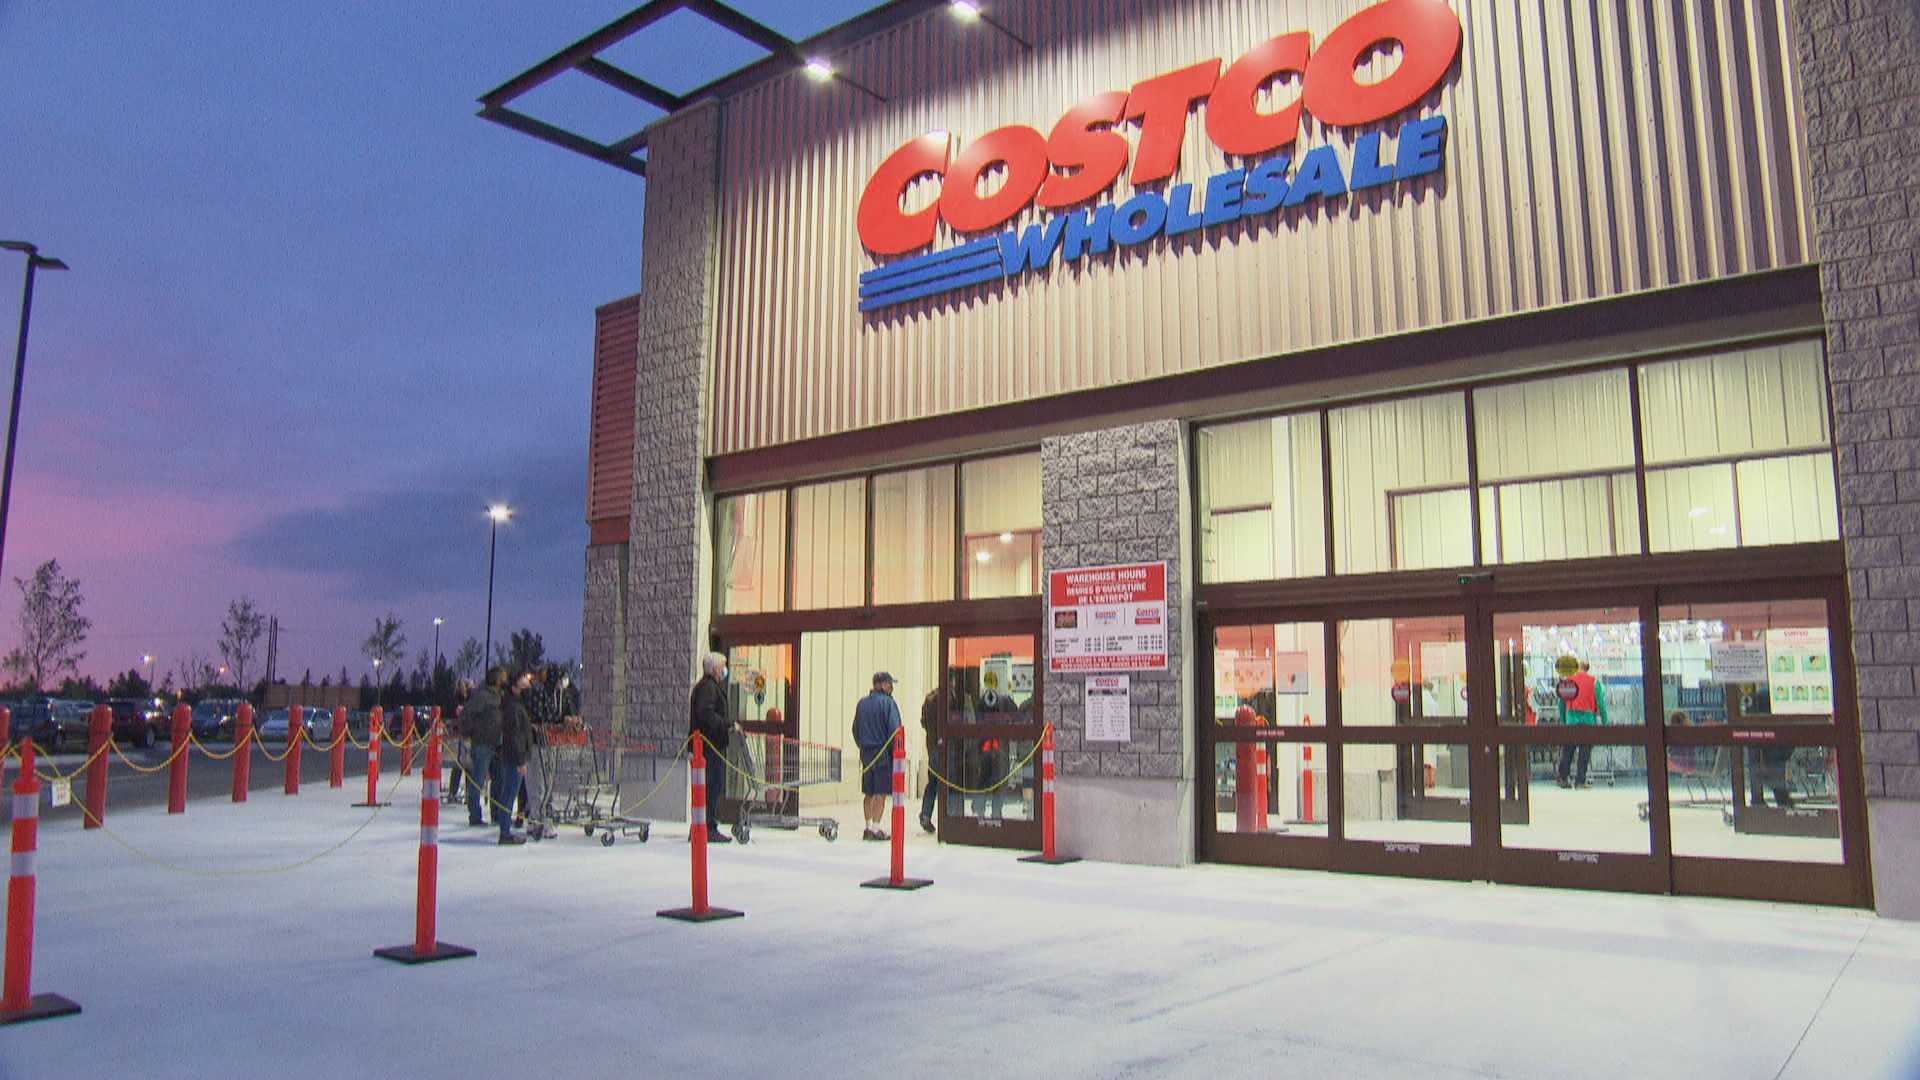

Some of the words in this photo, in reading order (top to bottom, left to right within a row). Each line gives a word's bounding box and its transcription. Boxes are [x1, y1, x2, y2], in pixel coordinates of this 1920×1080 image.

[857, 0, 1462, 255] COSTCO
[1000, 115, 1447, 276] WHOLESALE
[1066, 570, 1116, 584] WAREHOUSE
[1118, 568, 1147, 581] HOURS
